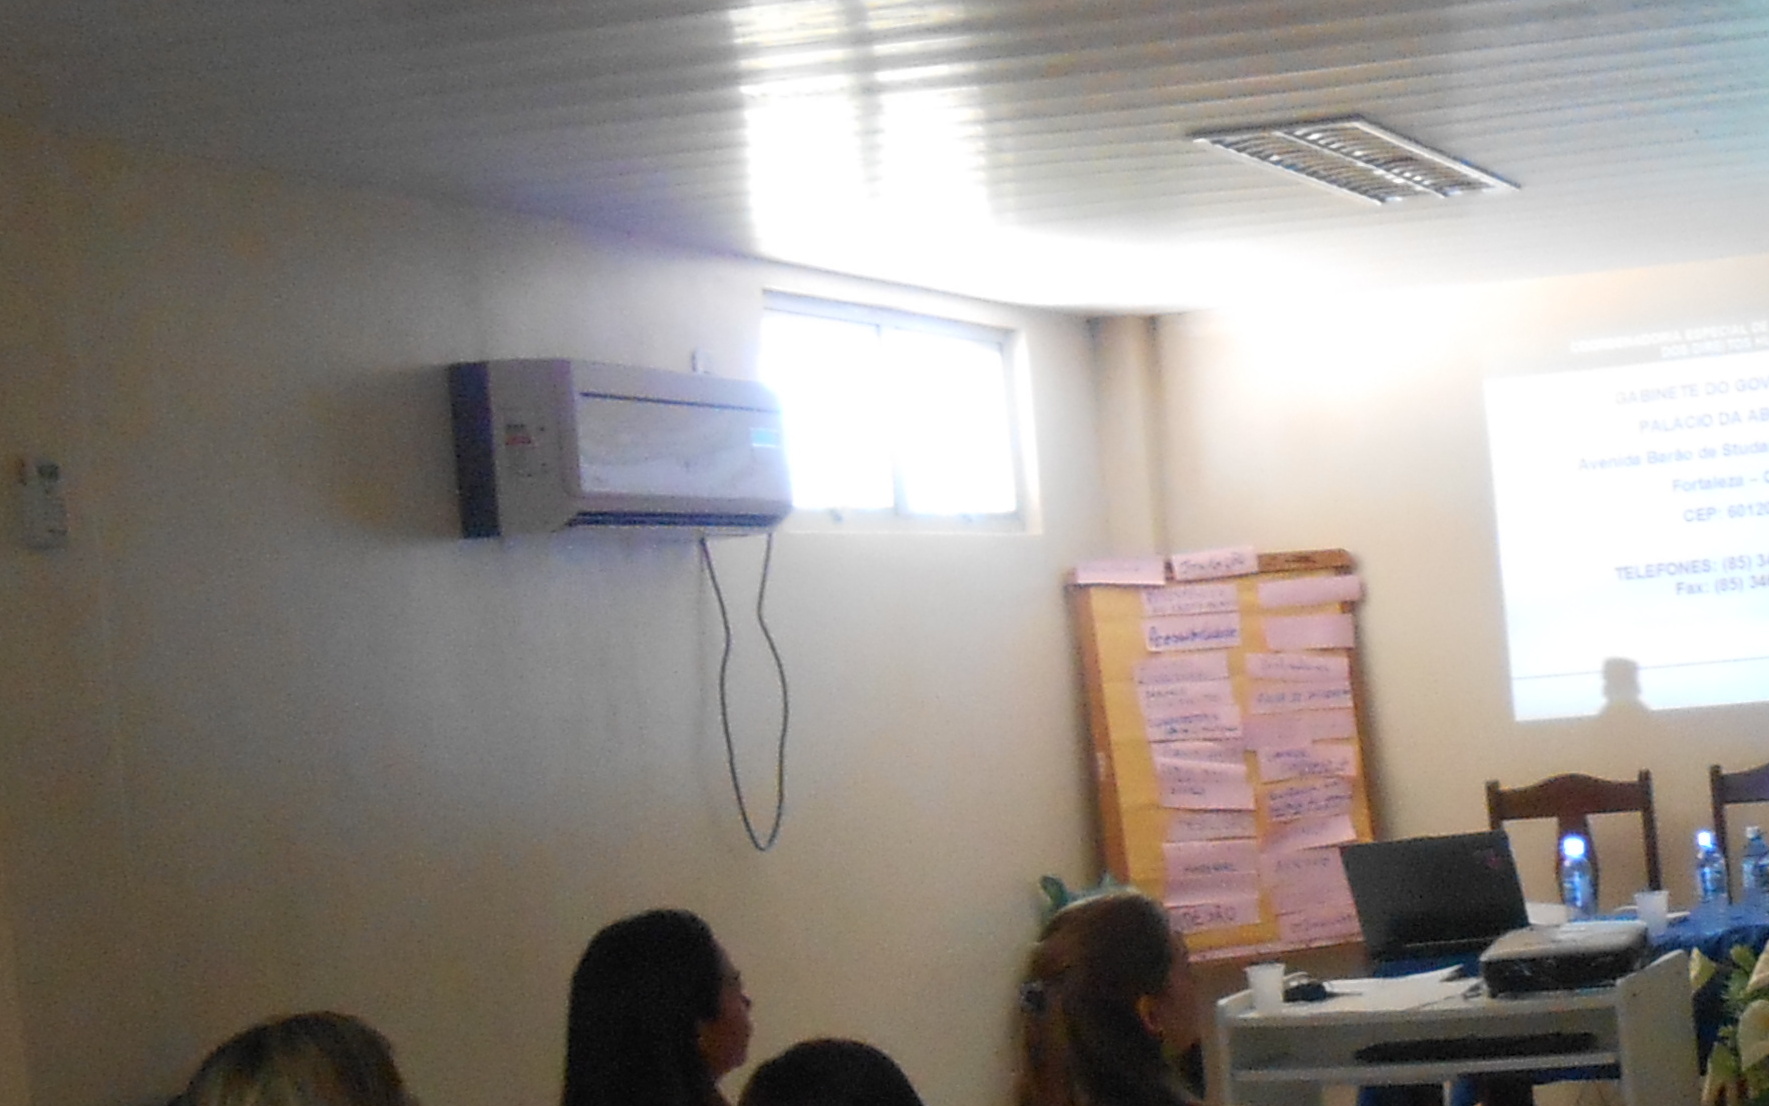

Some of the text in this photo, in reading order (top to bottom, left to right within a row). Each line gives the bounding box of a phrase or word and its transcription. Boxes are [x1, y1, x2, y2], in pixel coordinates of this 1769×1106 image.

[1752, 320, 1769, 334] DE
[1660, 344, 1688, 359] DOS
[1615, 382, 1700, 405] GABINETE
[1705, 379, 1730, 397] DO
[1718, 409, 1742, 427] DA
[1578, 452, 1642, 471] Avenida
[1646, 446, 1694, 465] Barão
[1698, 445, 1718, 460] de
[1671, 474, 1746, 494] Fortaleza
[1682, 505, 1724, 523] CEP:
[1614, 557, 1718, 581] TELEFONES:
[1721, 553, 1753, 574] (85)
[1675, 580, 1710, 596] Fax:
[1713, 575, 1744, 594] (85)
